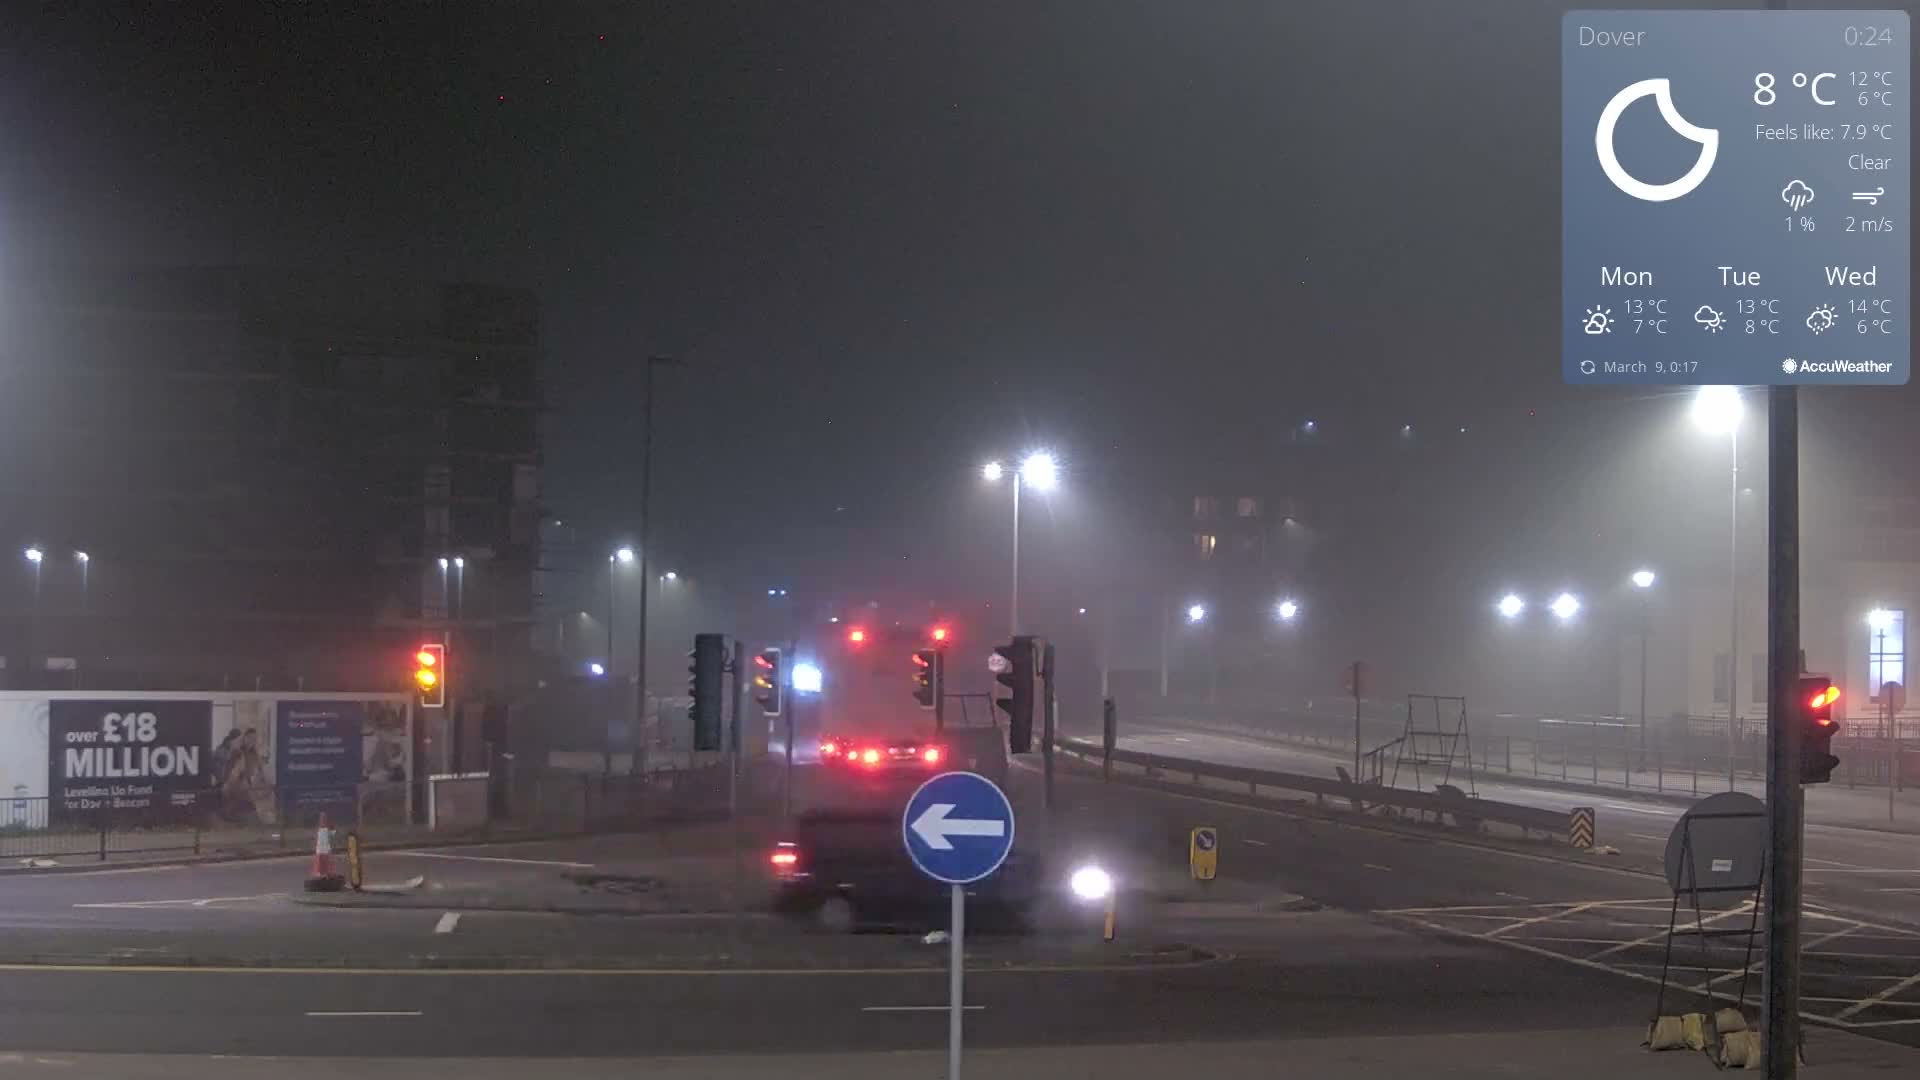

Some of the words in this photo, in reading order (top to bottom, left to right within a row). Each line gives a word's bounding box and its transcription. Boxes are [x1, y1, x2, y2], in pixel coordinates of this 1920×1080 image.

[65, 731, 98, 743] over
[103, 712, 157, 742] £18
[65, 746, 200, 778] MILLION
